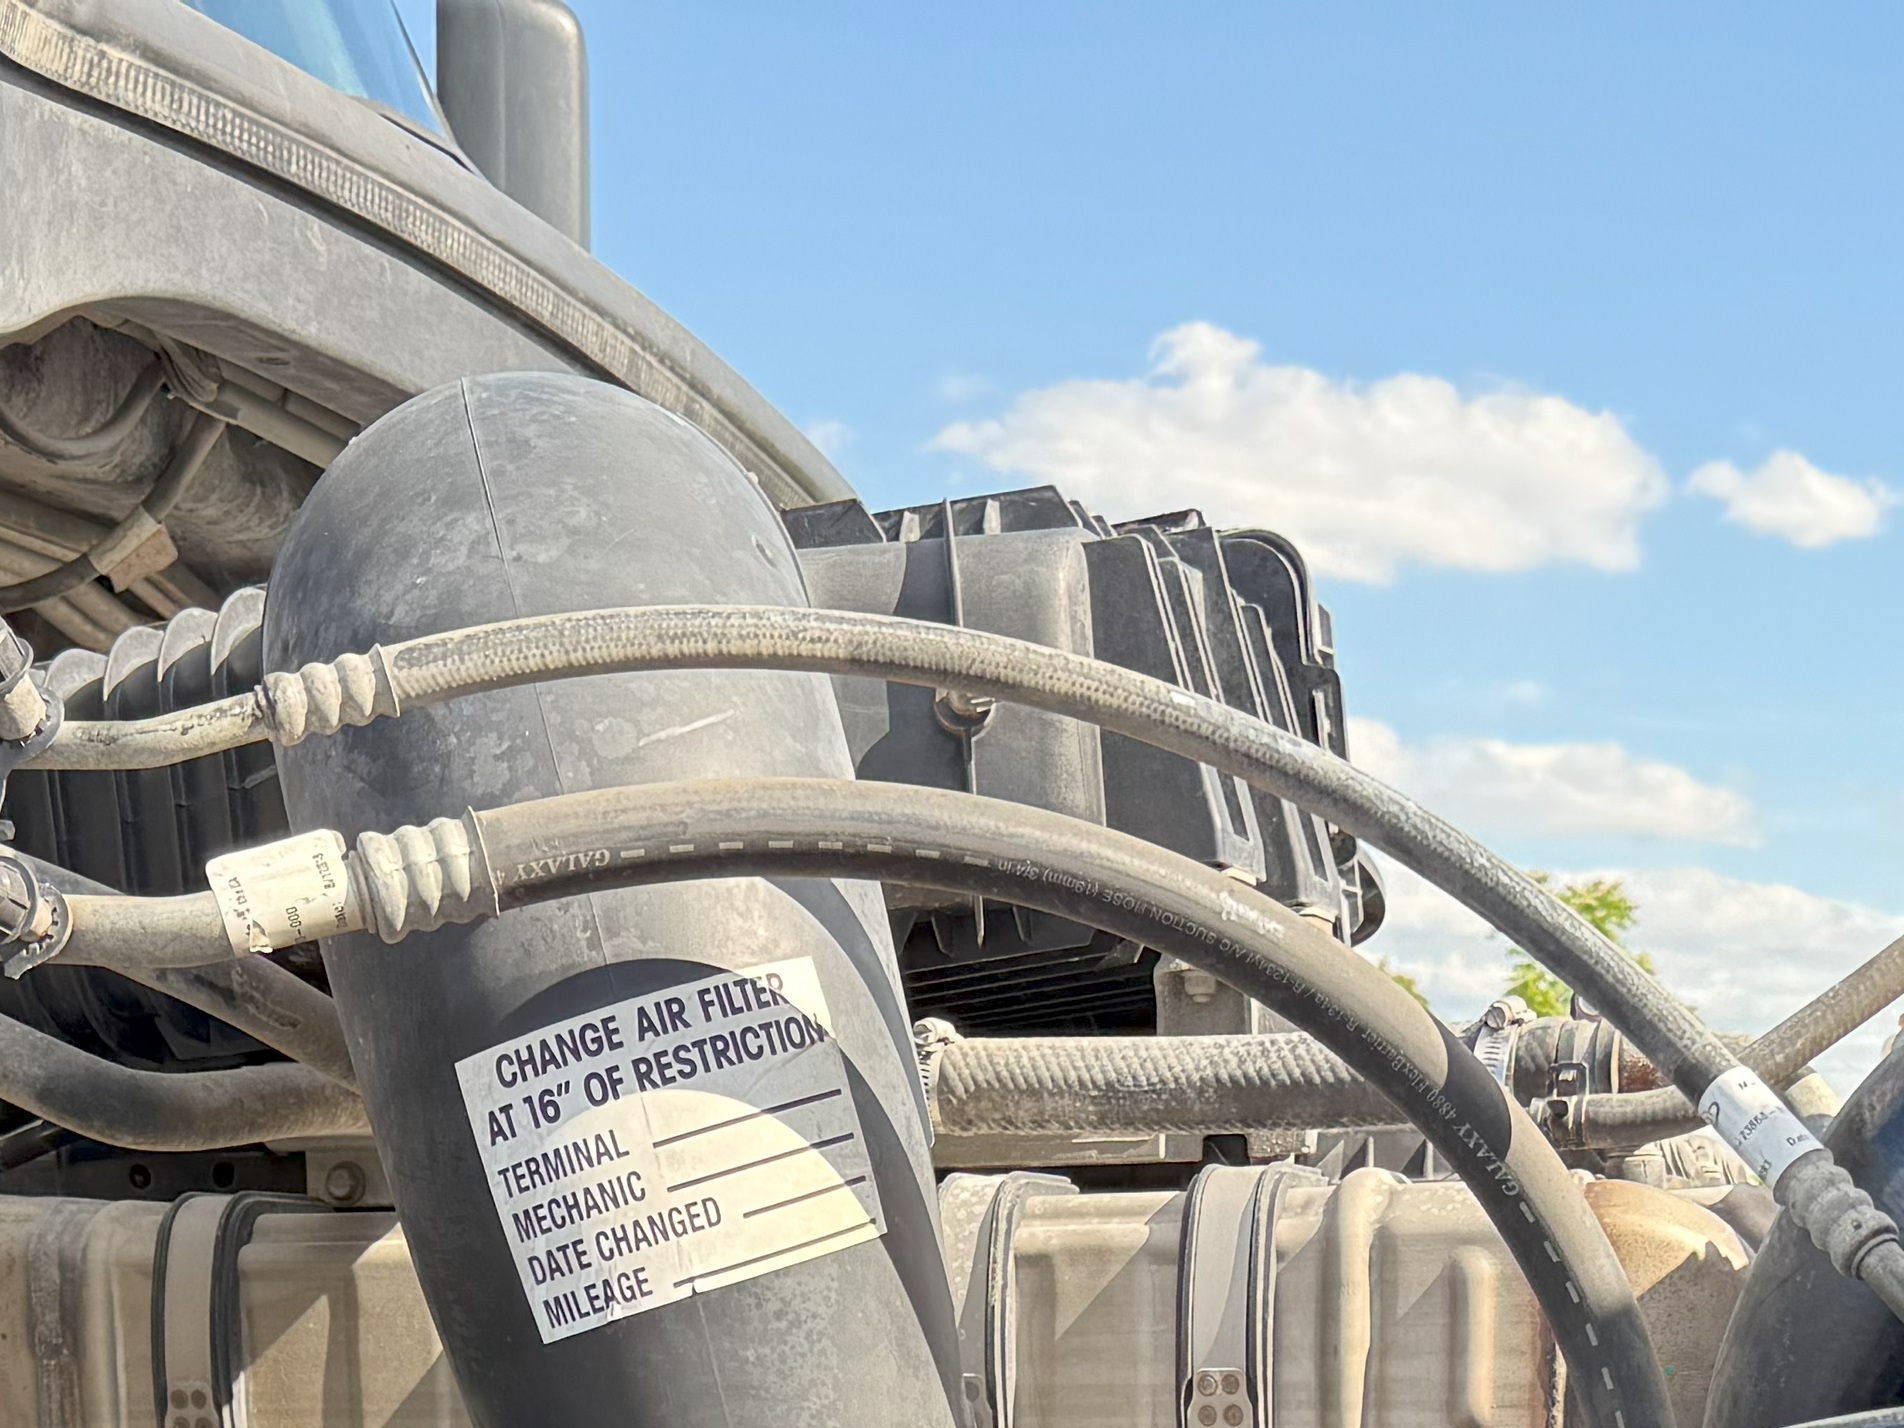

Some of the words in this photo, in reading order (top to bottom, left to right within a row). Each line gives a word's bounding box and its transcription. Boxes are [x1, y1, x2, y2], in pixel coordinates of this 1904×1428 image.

[515, 849, 611, 882] GALAXY
[1042, 865, 1099, 898] (19mm)
[1102, 889, 1150, 912] HOSE
[1151, 909, 1216, 946] SUCTION
[1219, 937, 1247, 959] A/C
[496, 1015, 624, 1088] CHANGE
[637, 997, 691, 1042] AIR
[696, 972, 790, 1022] FILTER
[1362, 1027, 1430, 1093] FlexBarrier
[488, 1105, 516, 1146] AT
[583, 1065, 624, 1107] OF
[632, 1013, 827, 1093] RESTRICTION
[498, 1130, 630, 1198] TERMINAL
[1453, 1123, 1520, 1196] GALAXY
[513, 1170, 646, 1243] MECHANIC
[528, 1239, 588, 1286] DATE
[596, 1196, 722, 1262] CHANGED
[543, 1266, 653, 1330] MILEAGE
